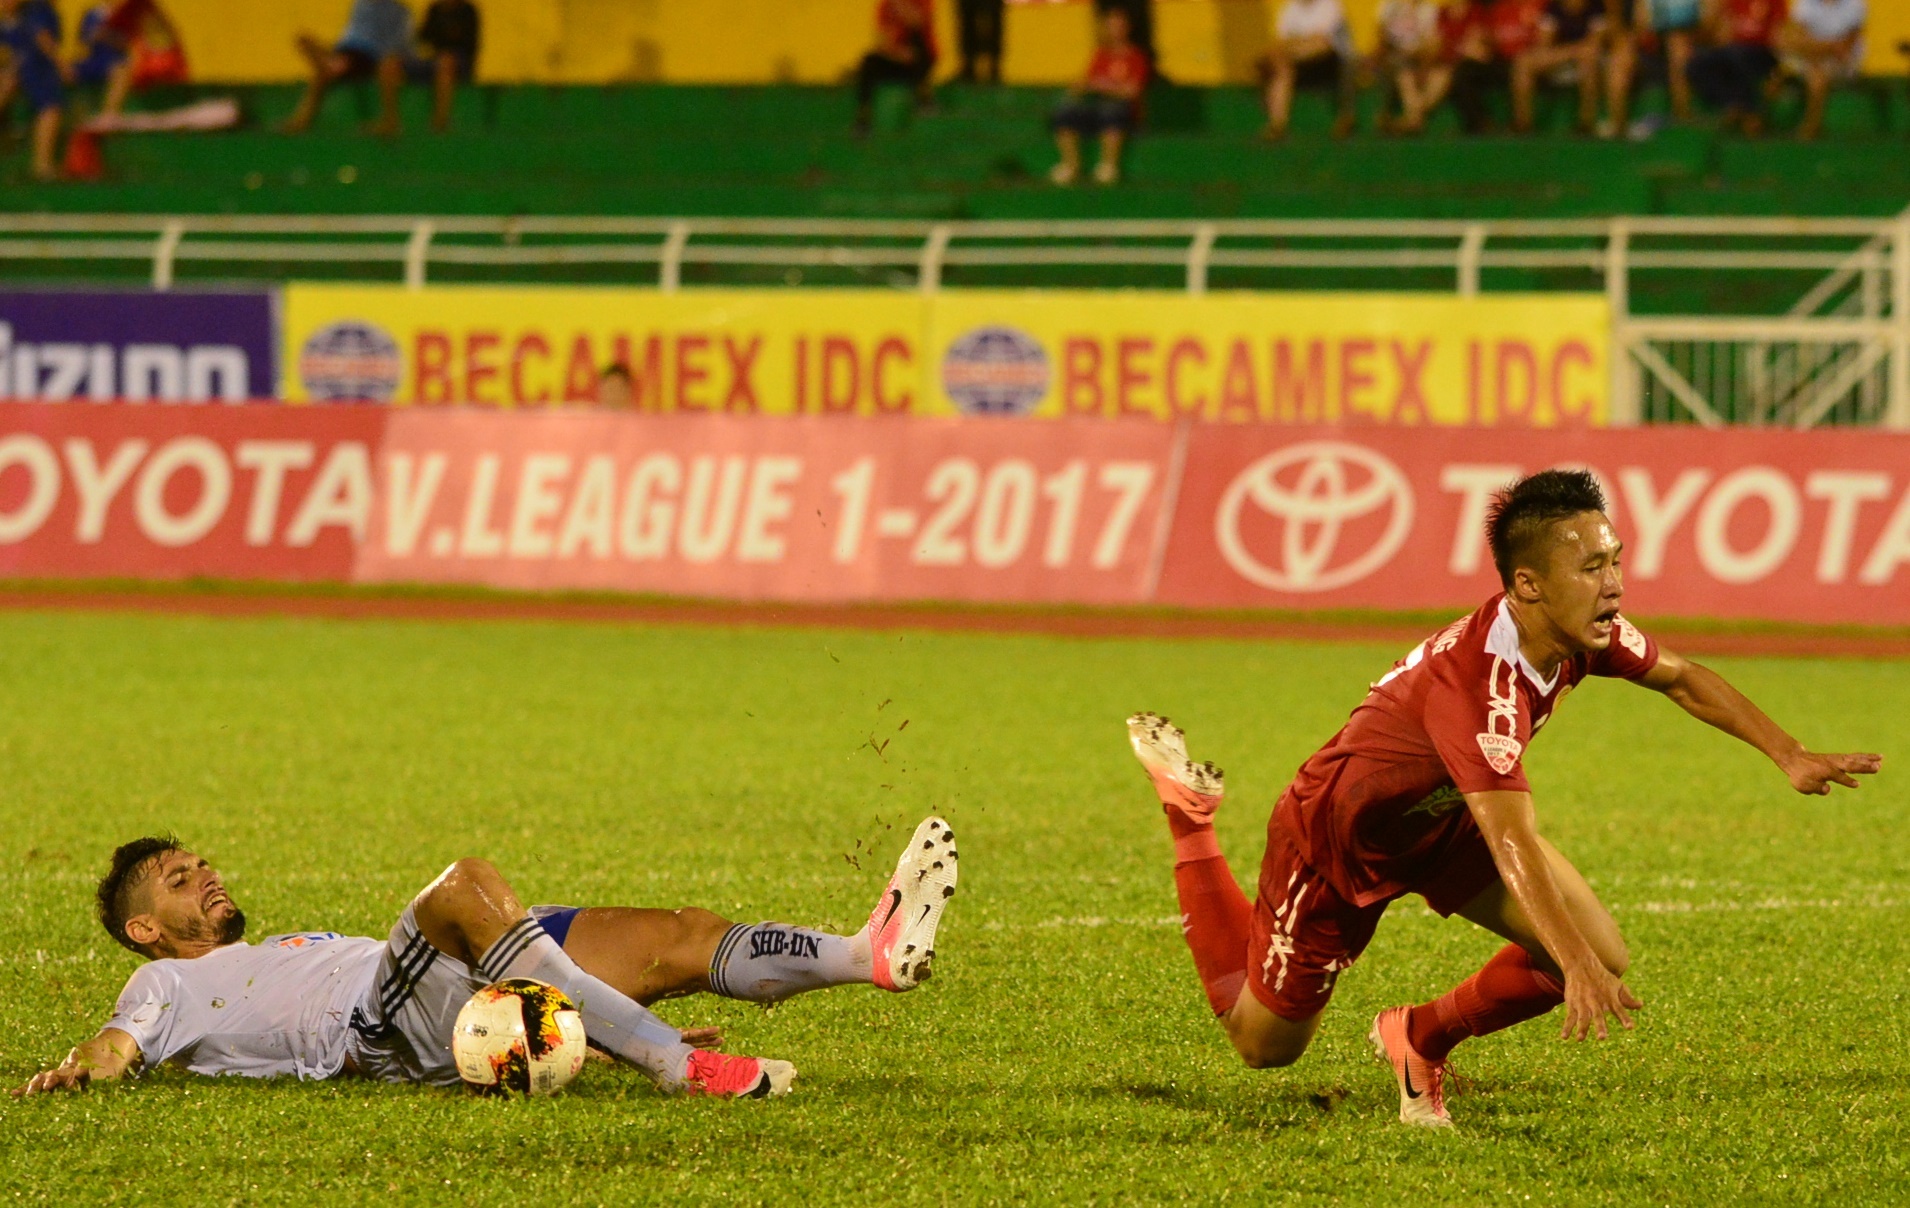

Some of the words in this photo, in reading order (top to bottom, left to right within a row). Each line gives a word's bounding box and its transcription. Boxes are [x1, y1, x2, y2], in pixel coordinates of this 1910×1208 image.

[413, 332, 764, 412] BECAMEX
[796, 334, 915, 415] IDC
[1061, 337, 1432, 424] BECAMEX
[1466, 340, 1594, 426] IDC
[387, 452, 802, 562] V.LEAGUE
[832, 456, 1155, 568] 1-2017
[1481, 736, 1518, 750] TOYOTA
[750, 929, 822, 960] SHB-DN
